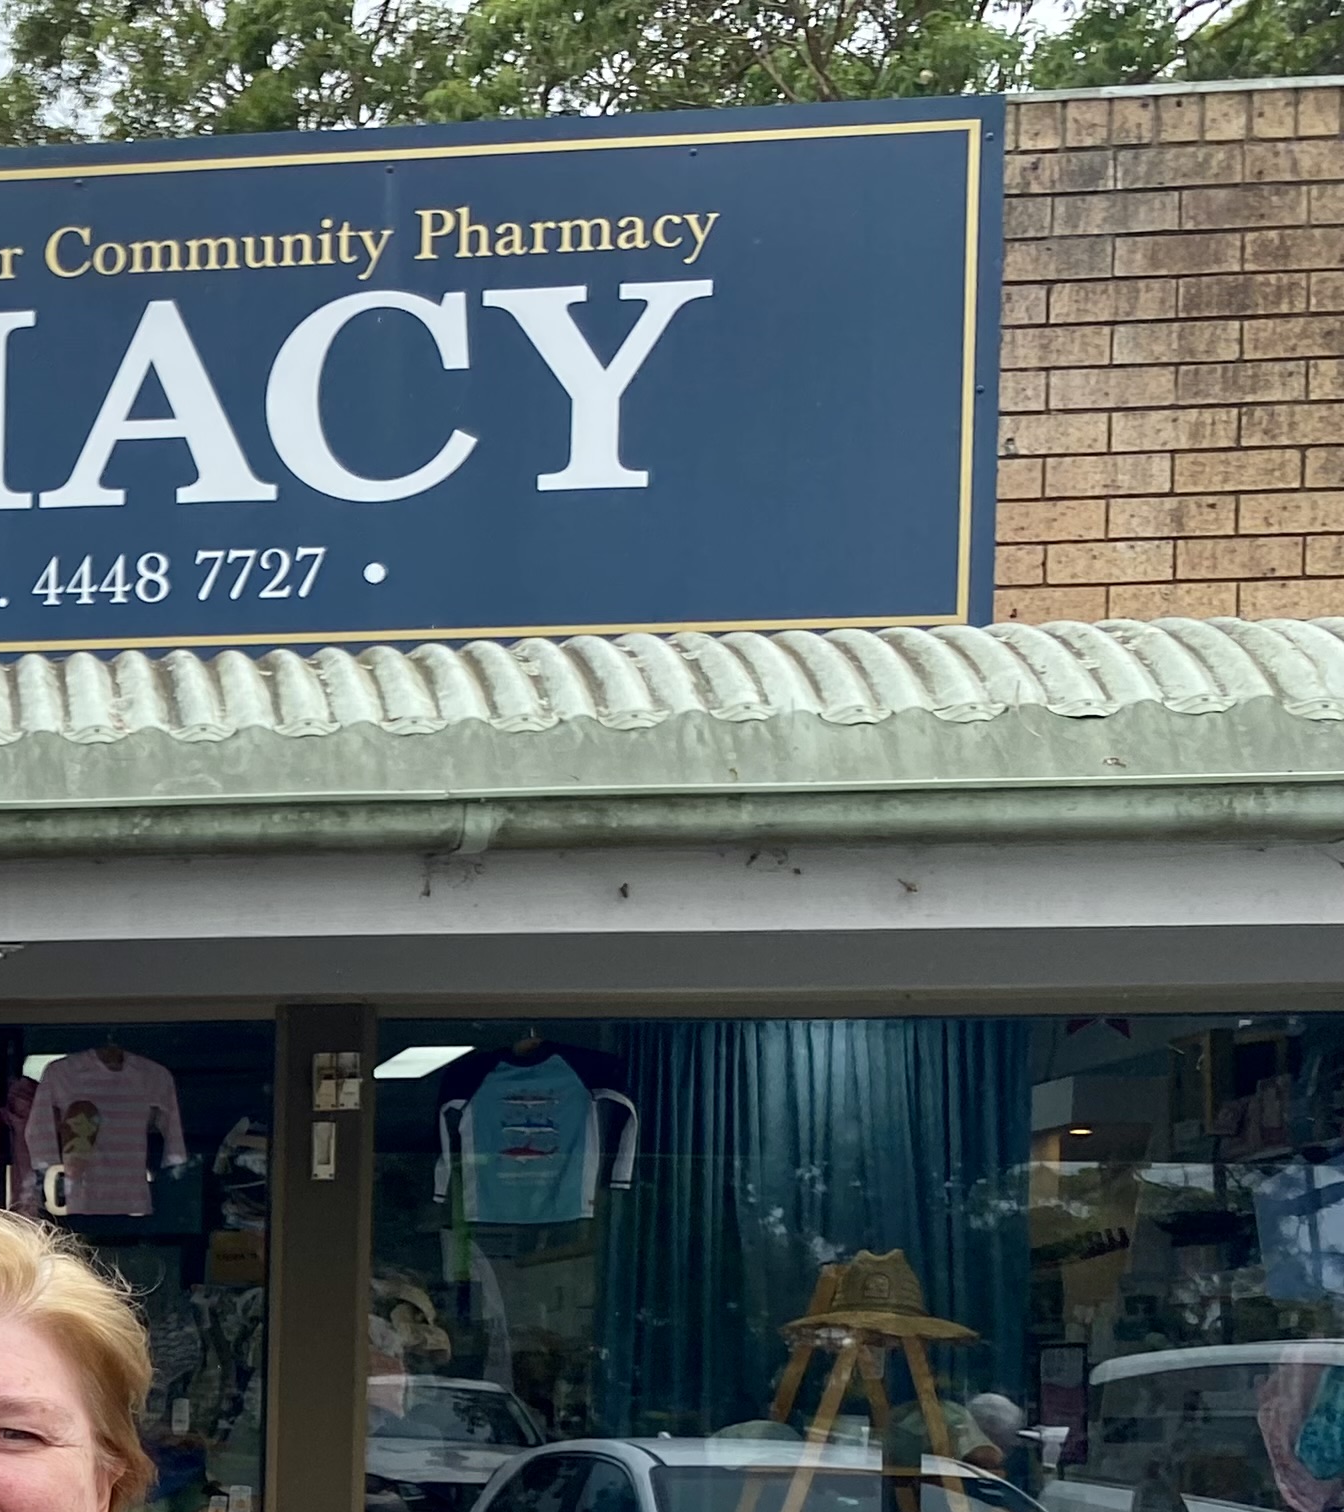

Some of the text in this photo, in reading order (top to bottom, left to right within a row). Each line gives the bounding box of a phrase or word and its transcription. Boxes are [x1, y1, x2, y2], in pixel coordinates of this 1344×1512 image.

[44, 227, 392, 279] Community
[414, 205, 721, 265] Pharmacy
[31, 552, 170, 606] 4448
[195, 546, 326, 601] 7727
